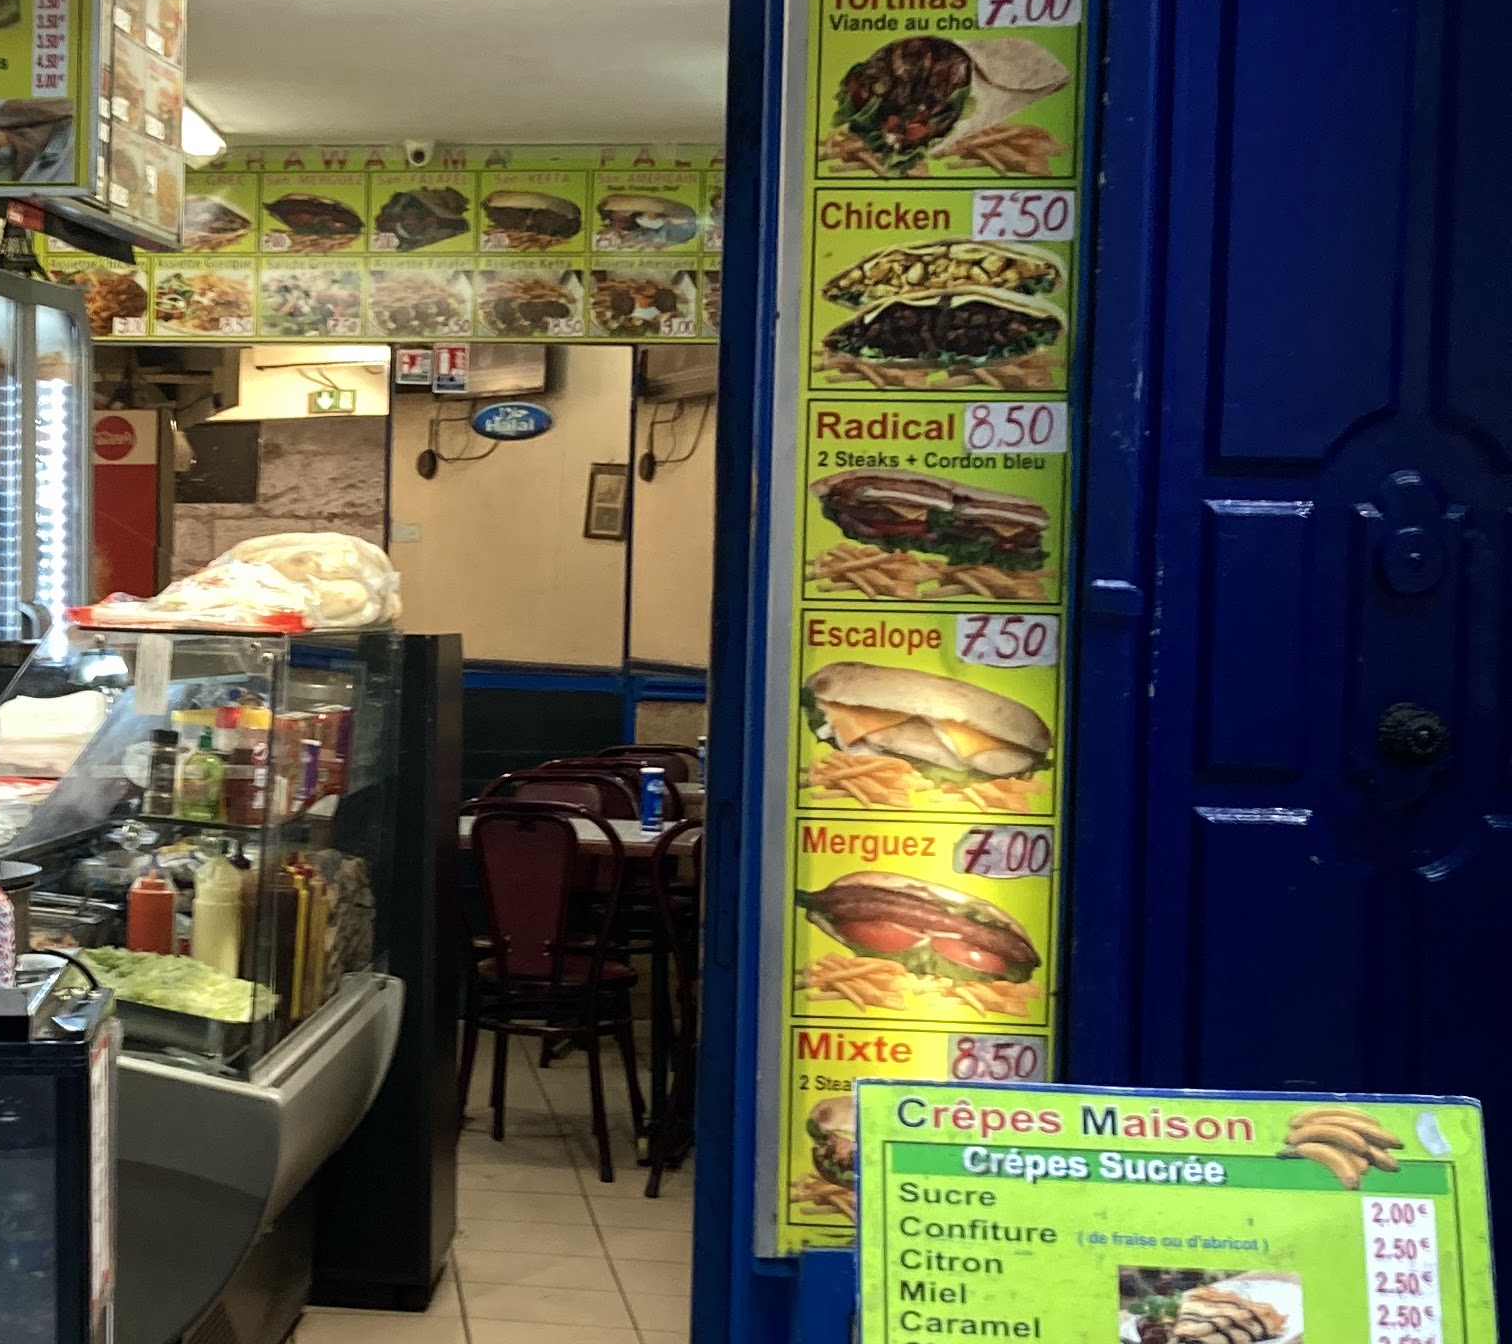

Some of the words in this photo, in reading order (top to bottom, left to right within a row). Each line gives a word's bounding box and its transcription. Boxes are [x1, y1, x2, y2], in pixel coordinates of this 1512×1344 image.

[829, 13, 900, 32] Viande
[904, 15, 930, 31] au
[820, 201, 952, 232] Chicken
[816, 411, 956, 441] Radical
[817, 452, 829, 468] 2
[834, 451, 900, 469] Steaks
[924, 453, 999, 470] Cordon
[1004, 453, 1046, 471] bleu
[807, 619, 943, 653] Escalope
[802, 827, 936, 862] Merguez
[798, 1033, 913, 1063] Mixte
[897, 1097, 1062, 1139] Crêpes
[1080, 1105, 1255, 1144] Maison
[963, 1145, 1090, 1185] Crépes
[1098, 1151, 1228, 1184] Sucrée
[900, 1183, 997, 1208] Sucre
[899, 1216, 1058, 1245] Confiture
[899, 1249, 1004, 1276] Citron
[900, 1282, 967, 1306] Miel
[900, 1311, 1041, 1339] Caramel
